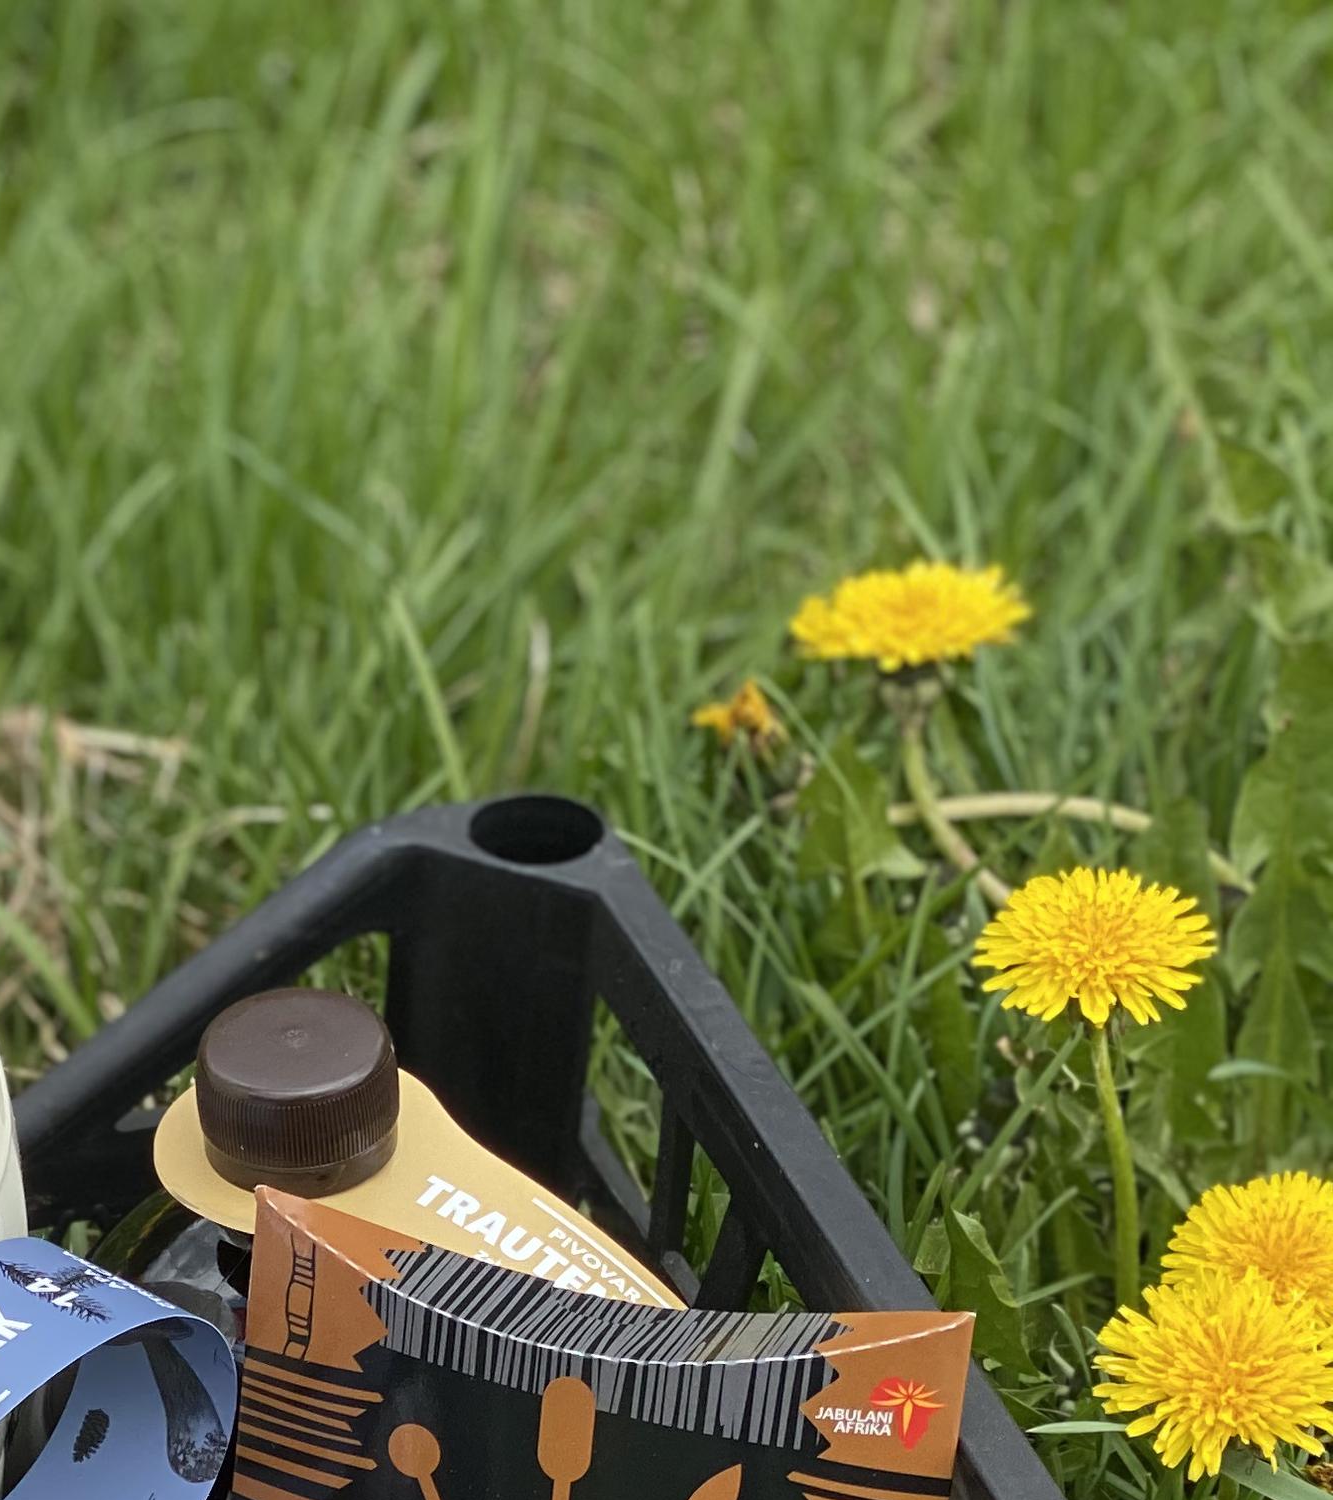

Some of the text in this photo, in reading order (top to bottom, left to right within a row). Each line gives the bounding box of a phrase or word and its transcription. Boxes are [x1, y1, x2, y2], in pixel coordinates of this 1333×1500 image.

[548, 1228, 643, 1303] PIVOVAR
[814, 1406, 894, 1424] JABULANI
[833, 1420, 892, 1437] AFRIKA
